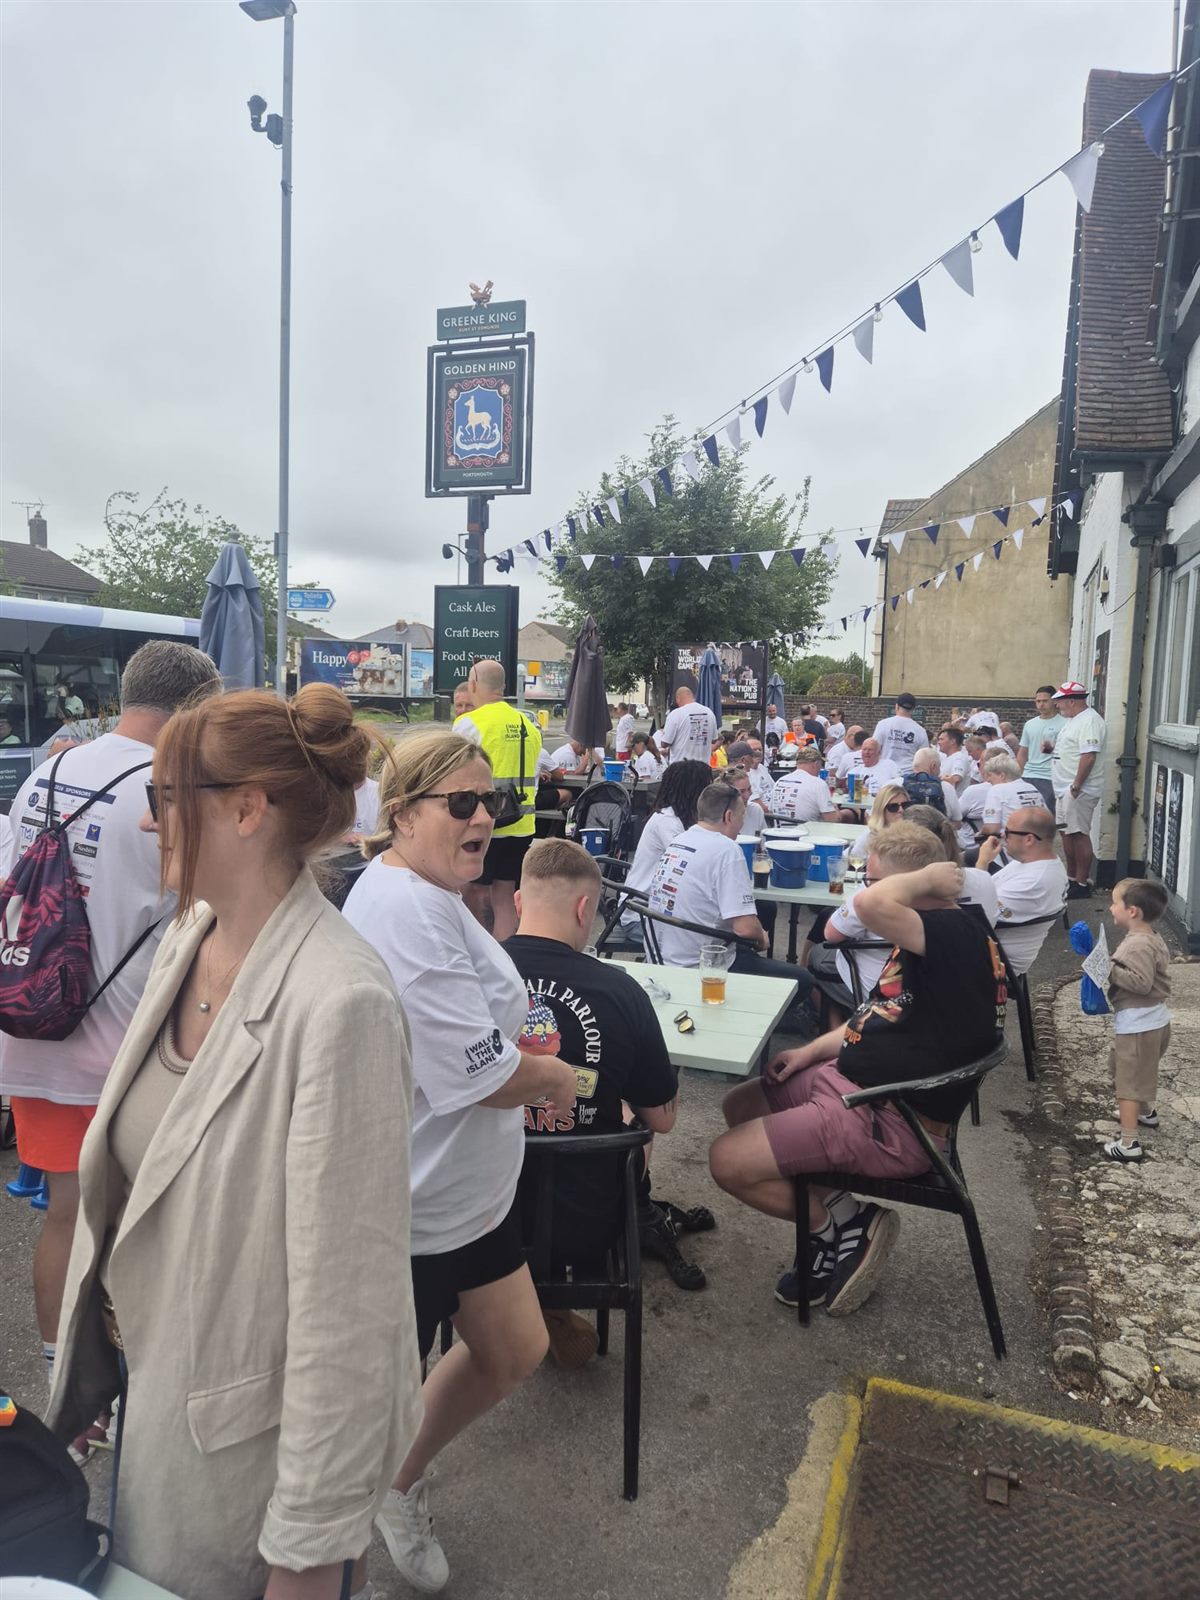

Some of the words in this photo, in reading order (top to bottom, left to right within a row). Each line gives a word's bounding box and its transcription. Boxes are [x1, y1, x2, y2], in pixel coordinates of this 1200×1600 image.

[442, 314, 486, 328] GREENE
[488, 311, 517, 323] KING
[443, 363, 486, 376] GOLDEN
[488, 360, 517, 371] HIND
[448, 601, 473, 613] Cask
[474, 601, 497, 613] Ales
[444, 626, 470, 638] Craft
[471, 627, 500, 638] Beers
[442, 651, 466, 661] Food
[678, 648, 691, 656] THE
[312, 650, 349, 667] Happy
[453, 666, 468, 677] All
[745, 678, 758, 686] THE
[729, 685, 758, 693] NATION'S
[522, 978, 558, 998] ALL
[559, 986, 601, 1064] PARLOUR
[475, 1045, 493, 1060] THE
[466, 1052, 497, 1075] ISLAND
